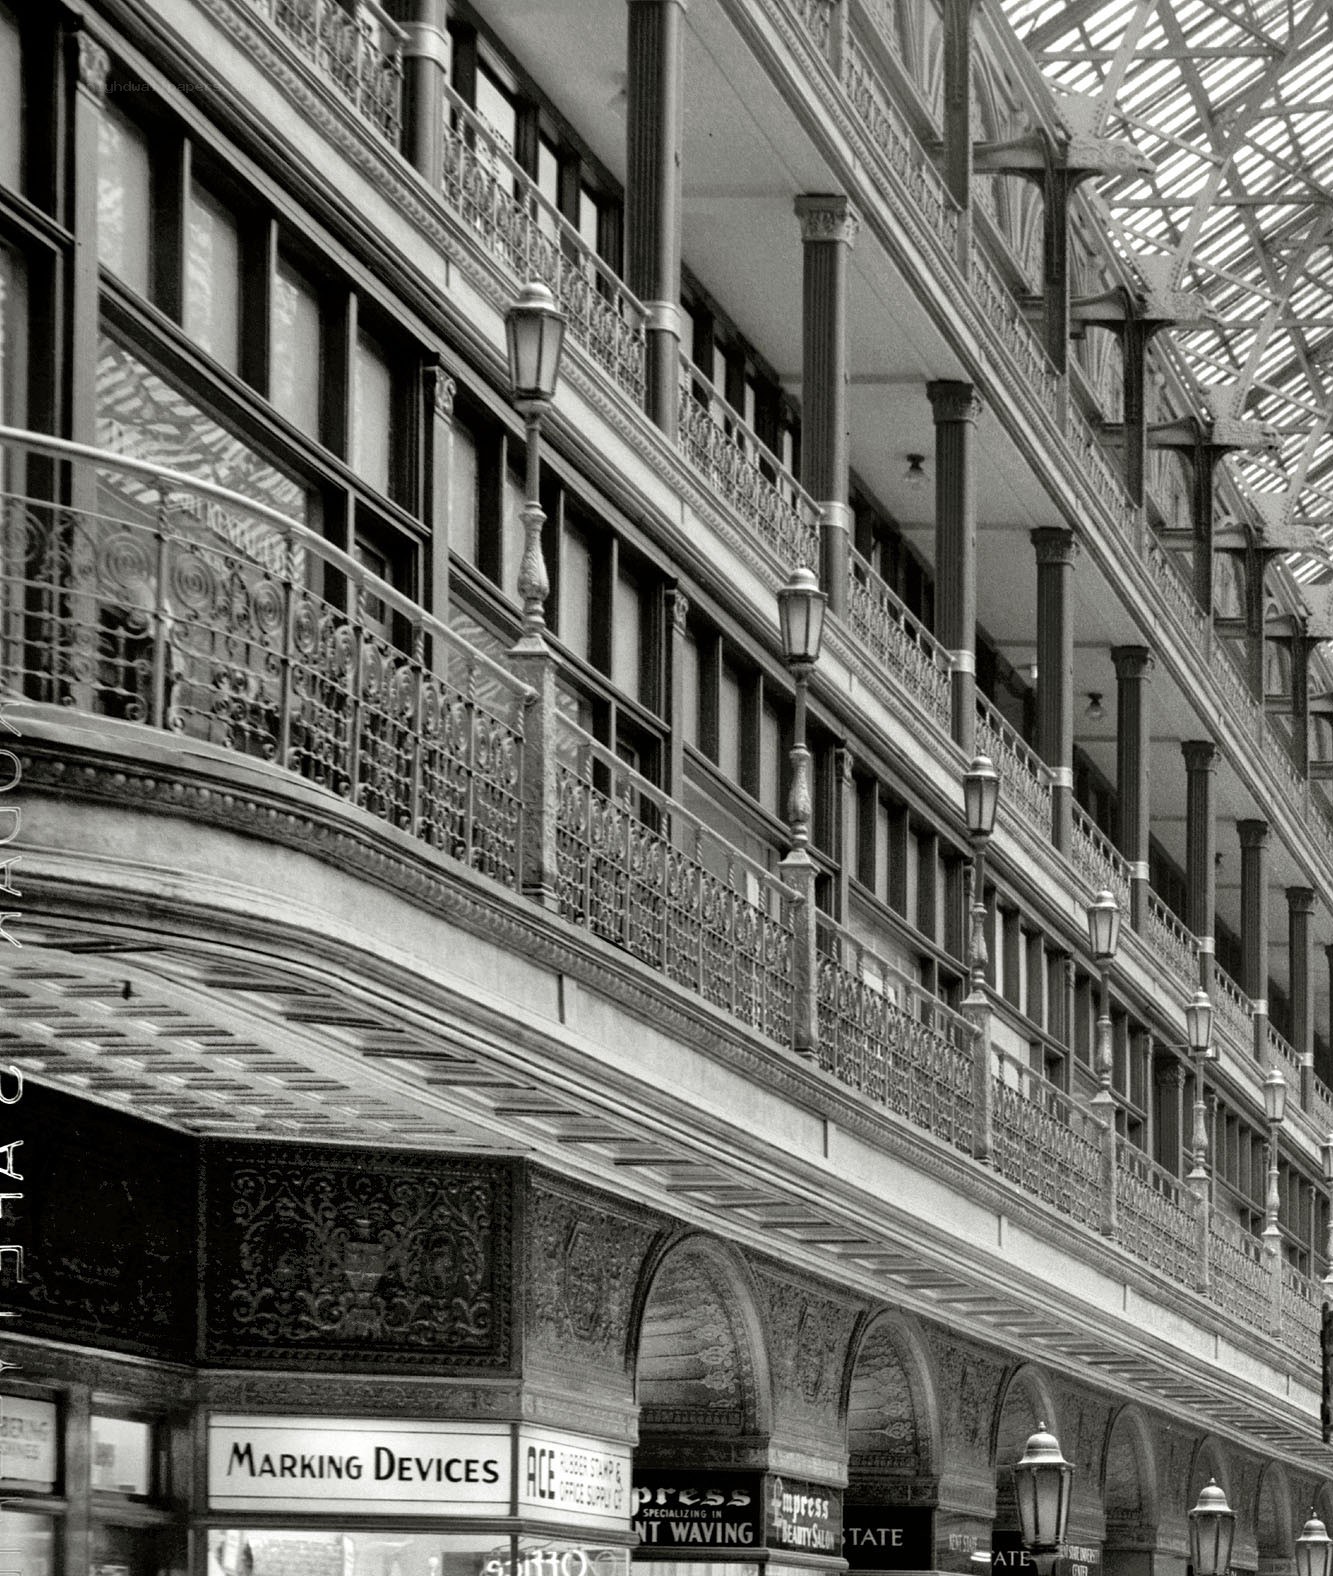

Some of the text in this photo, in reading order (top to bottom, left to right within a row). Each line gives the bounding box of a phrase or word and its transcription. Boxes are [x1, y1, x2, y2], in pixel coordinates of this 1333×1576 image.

[227, 1442, 499, 1484] MARKING DEVICES
[526, 1446, 556, 1498] ACE
[643, 1508, 722, 1519] SPECIALIZING IN
[670, 1521, 754, 1545] WAVING
